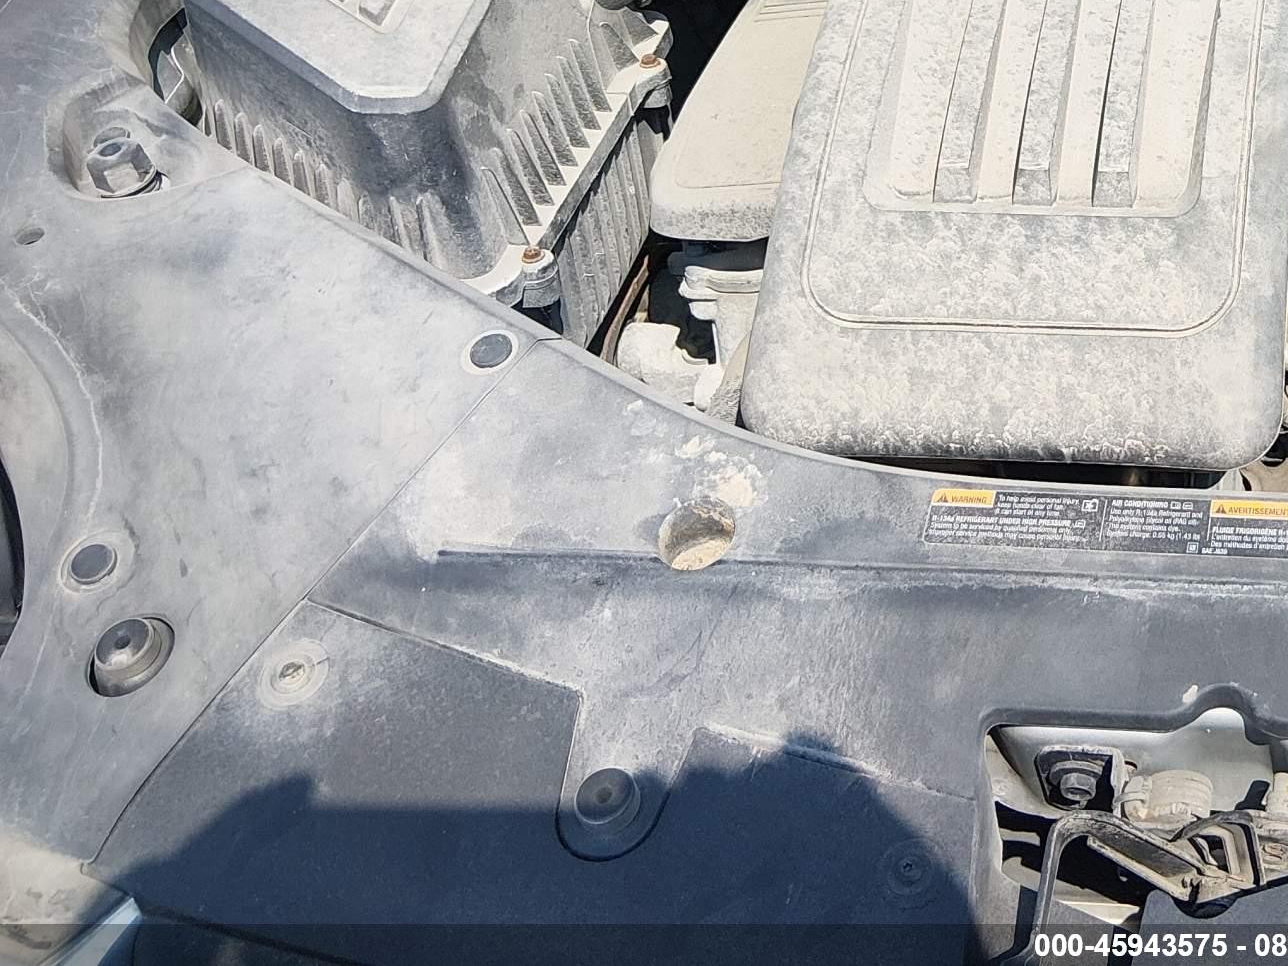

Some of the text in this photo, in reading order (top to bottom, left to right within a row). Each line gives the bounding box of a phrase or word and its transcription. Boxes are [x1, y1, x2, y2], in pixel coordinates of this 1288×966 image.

[951, 495, 988, 504] WARNING
[1124, 500, 1168, 509] CONDITIONING
[1158, 510, 1190, 519] Refrigerant
[956, 516, 998, 524] REFRIGERANT
